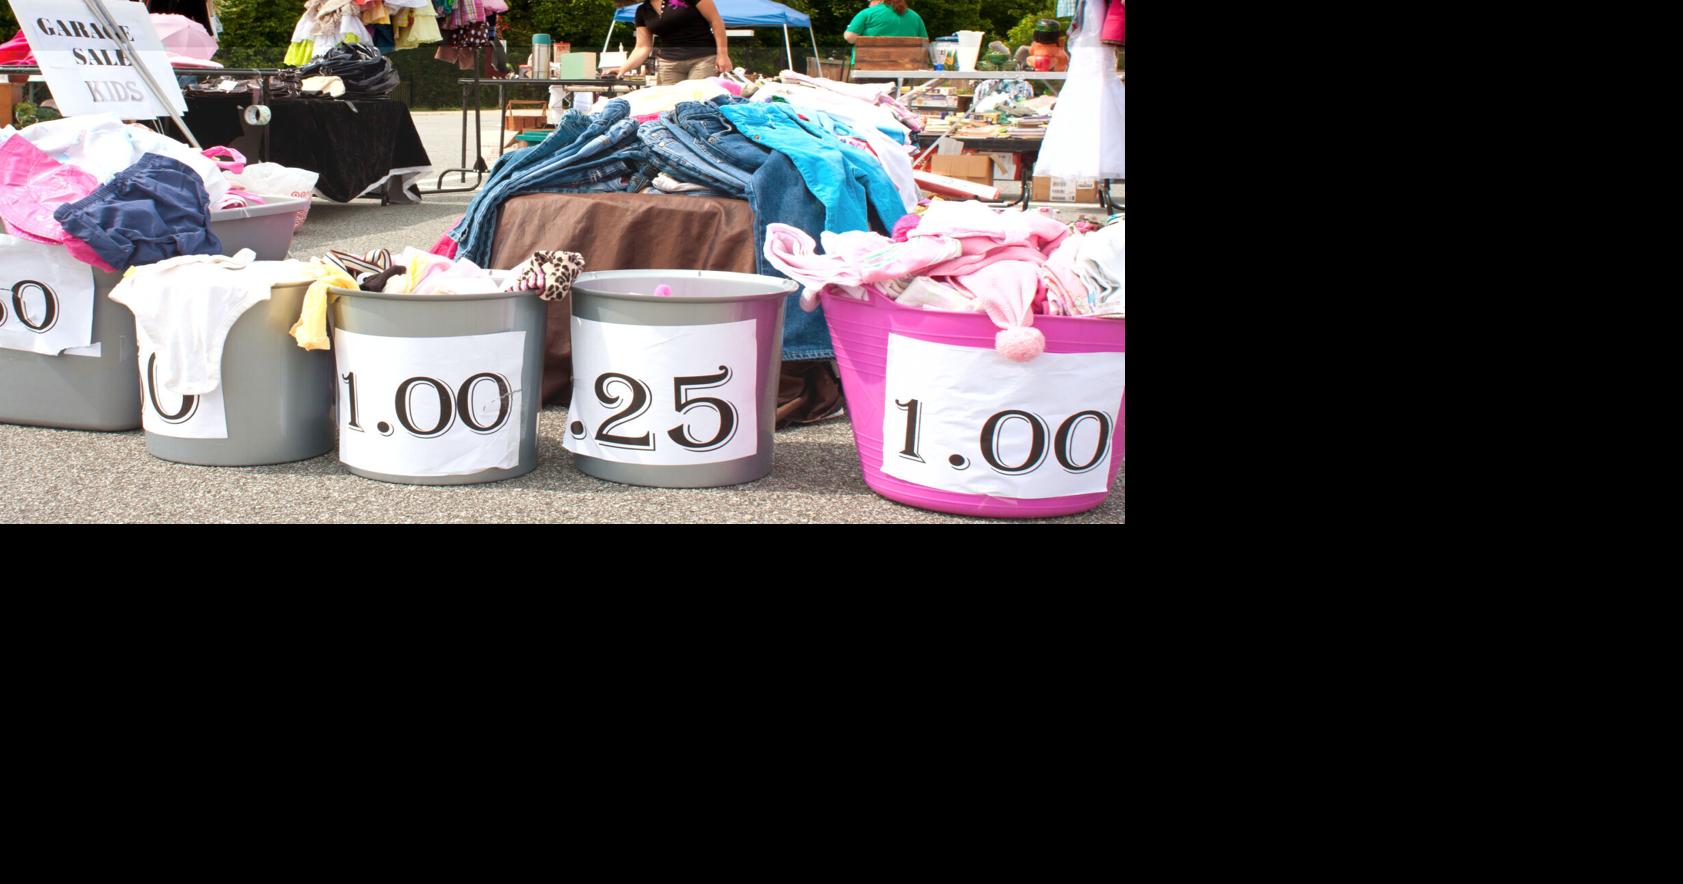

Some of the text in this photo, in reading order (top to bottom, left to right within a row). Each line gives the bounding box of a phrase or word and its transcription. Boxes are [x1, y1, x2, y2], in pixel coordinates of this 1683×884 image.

[85, 80, 145, 103] KIDS
[342, 371, 513, 439] 1.00
[570, 365, 739, 452] .25
[895, 398, 1114, 476] 1.00
